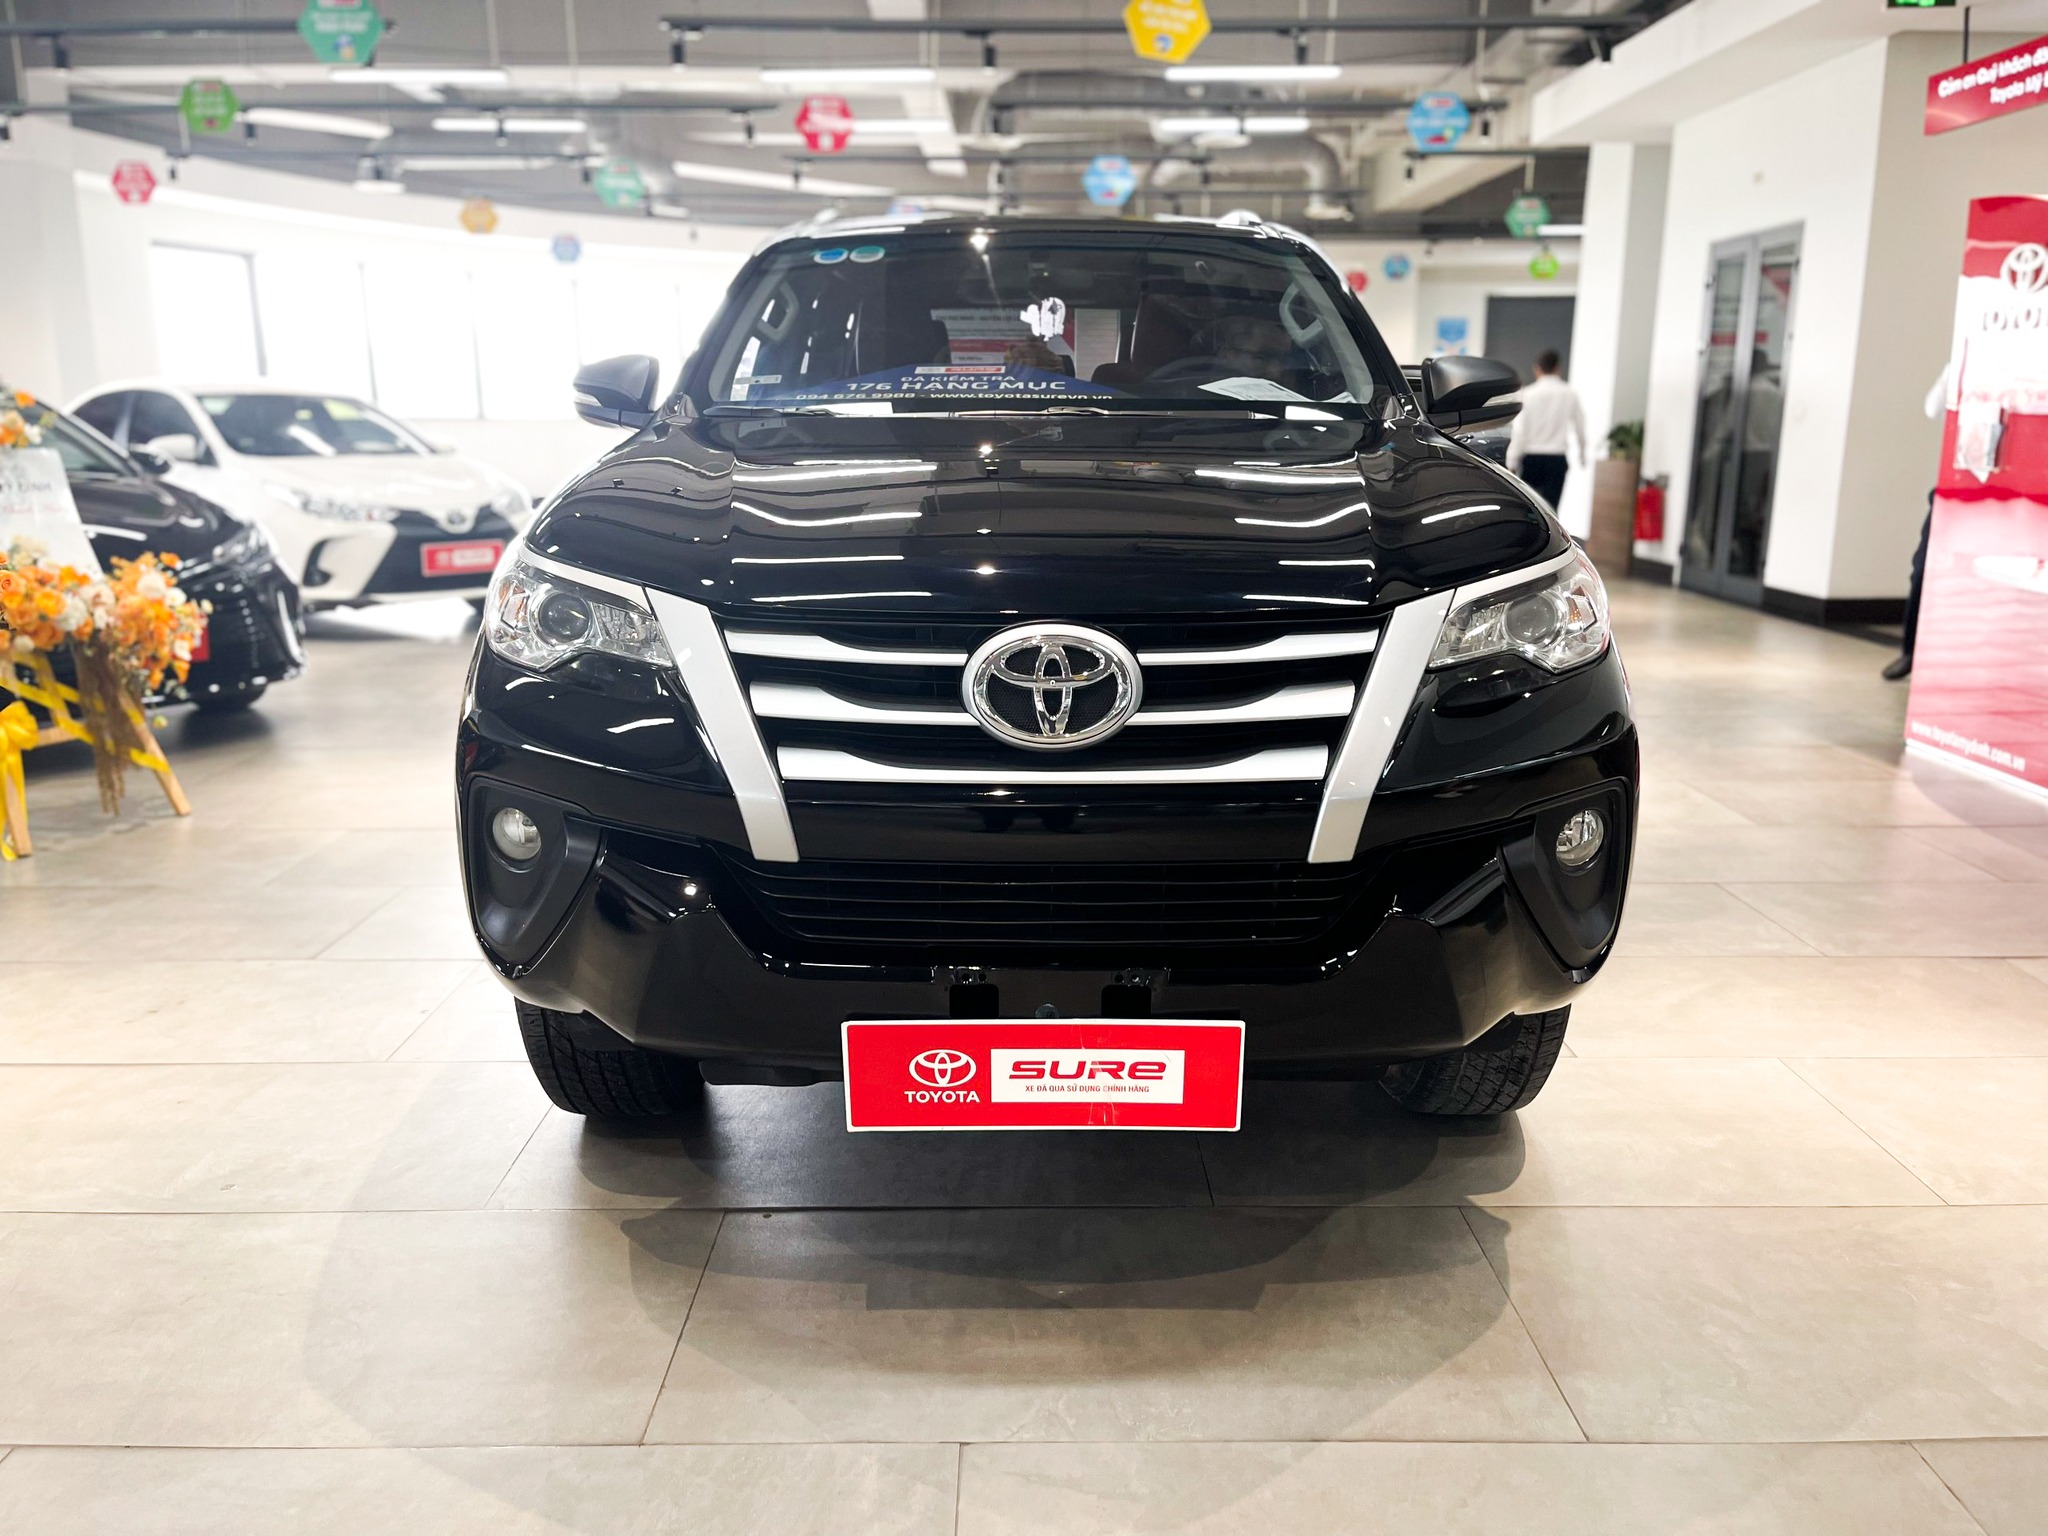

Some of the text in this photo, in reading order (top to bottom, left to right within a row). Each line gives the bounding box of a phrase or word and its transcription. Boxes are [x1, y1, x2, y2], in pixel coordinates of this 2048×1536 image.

[847, 381, 1066, 391] 176 HẠNG MỤC
[1009, 1060, 1167, 1080] SURE
[1025, 1083, 1150, 1094] XE ĐÃ QUA SỬ DỤNG CHÍNH HÃNG
[904, 1090, 980, 1104] TOYOTA
